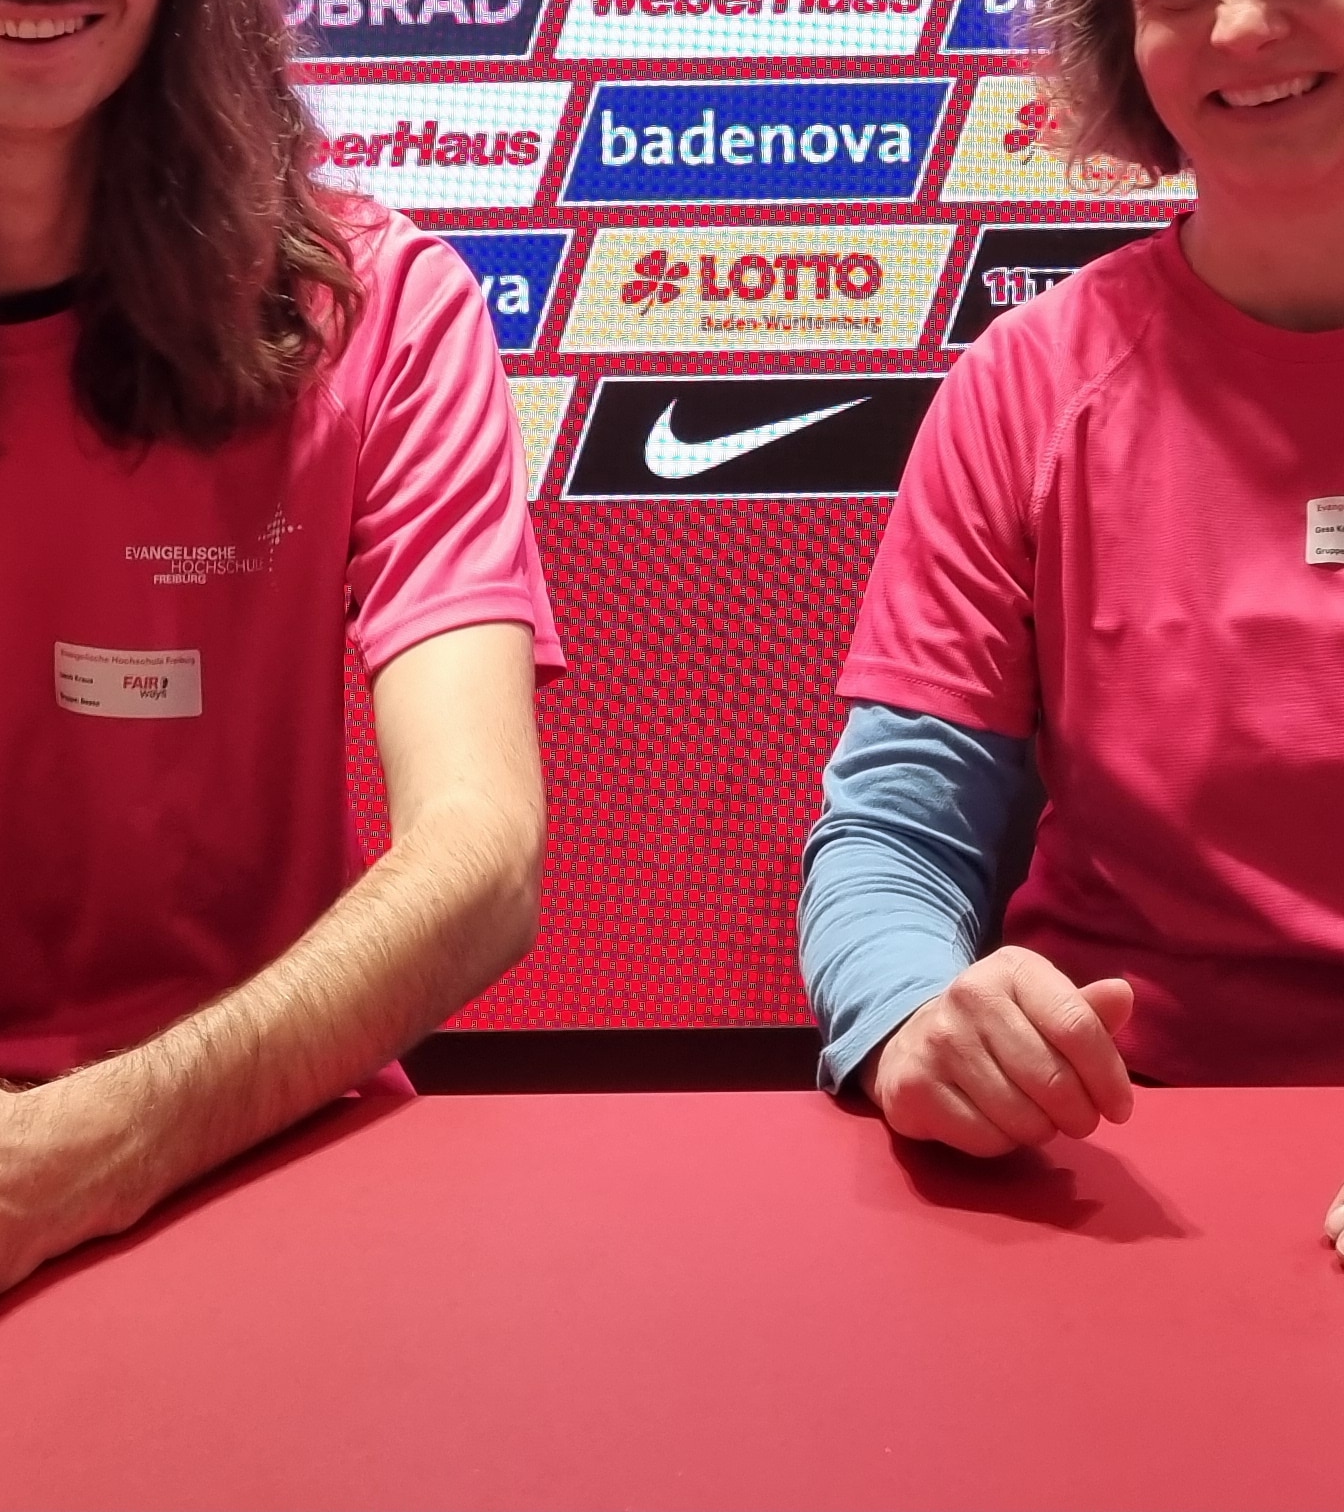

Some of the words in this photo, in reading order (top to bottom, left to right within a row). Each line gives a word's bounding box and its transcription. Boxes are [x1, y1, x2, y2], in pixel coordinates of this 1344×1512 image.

[600, 108, 912, 168] badenova
[699, 252, 884, 302] LOTTO
[125, 546, 236, 560] EVANGELISCHE
[153, 573, 207, 585] FREIBURG
[123, 675, 159, 689] FAIR
